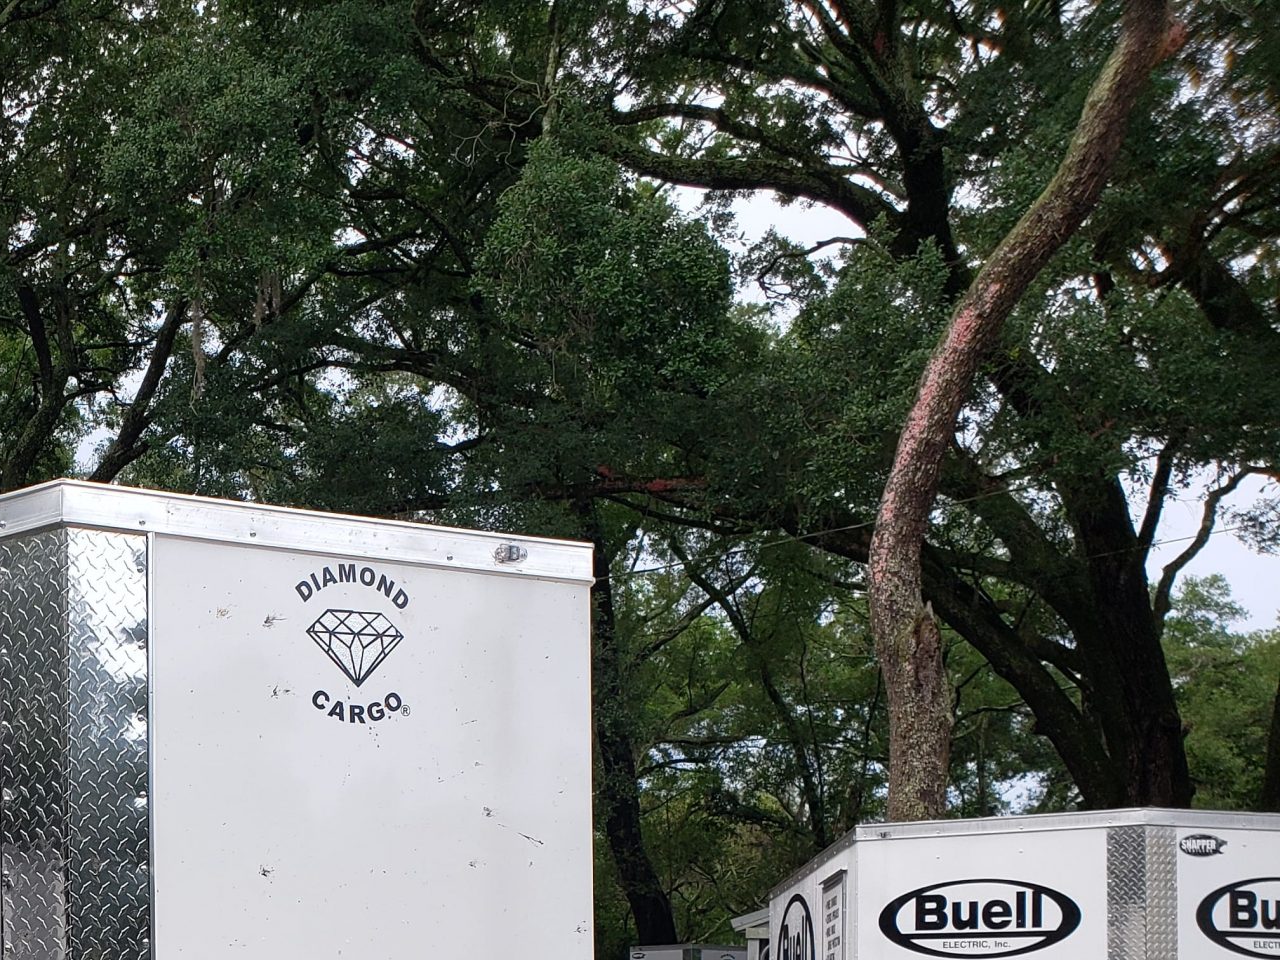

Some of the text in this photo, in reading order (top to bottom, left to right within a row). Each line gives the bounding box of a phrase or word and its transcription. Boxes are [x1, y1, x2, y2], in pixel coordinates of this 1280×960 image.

[294, 563, 409, 610] DIAMOND
[1180, 838, 1217, 851] SNAPPER
[915, 890, 1043, 931] Buell
[942, 940, 1011, 950] ELECTRIC, Inc.
[1253, 940, 1280, 949] ELECT
